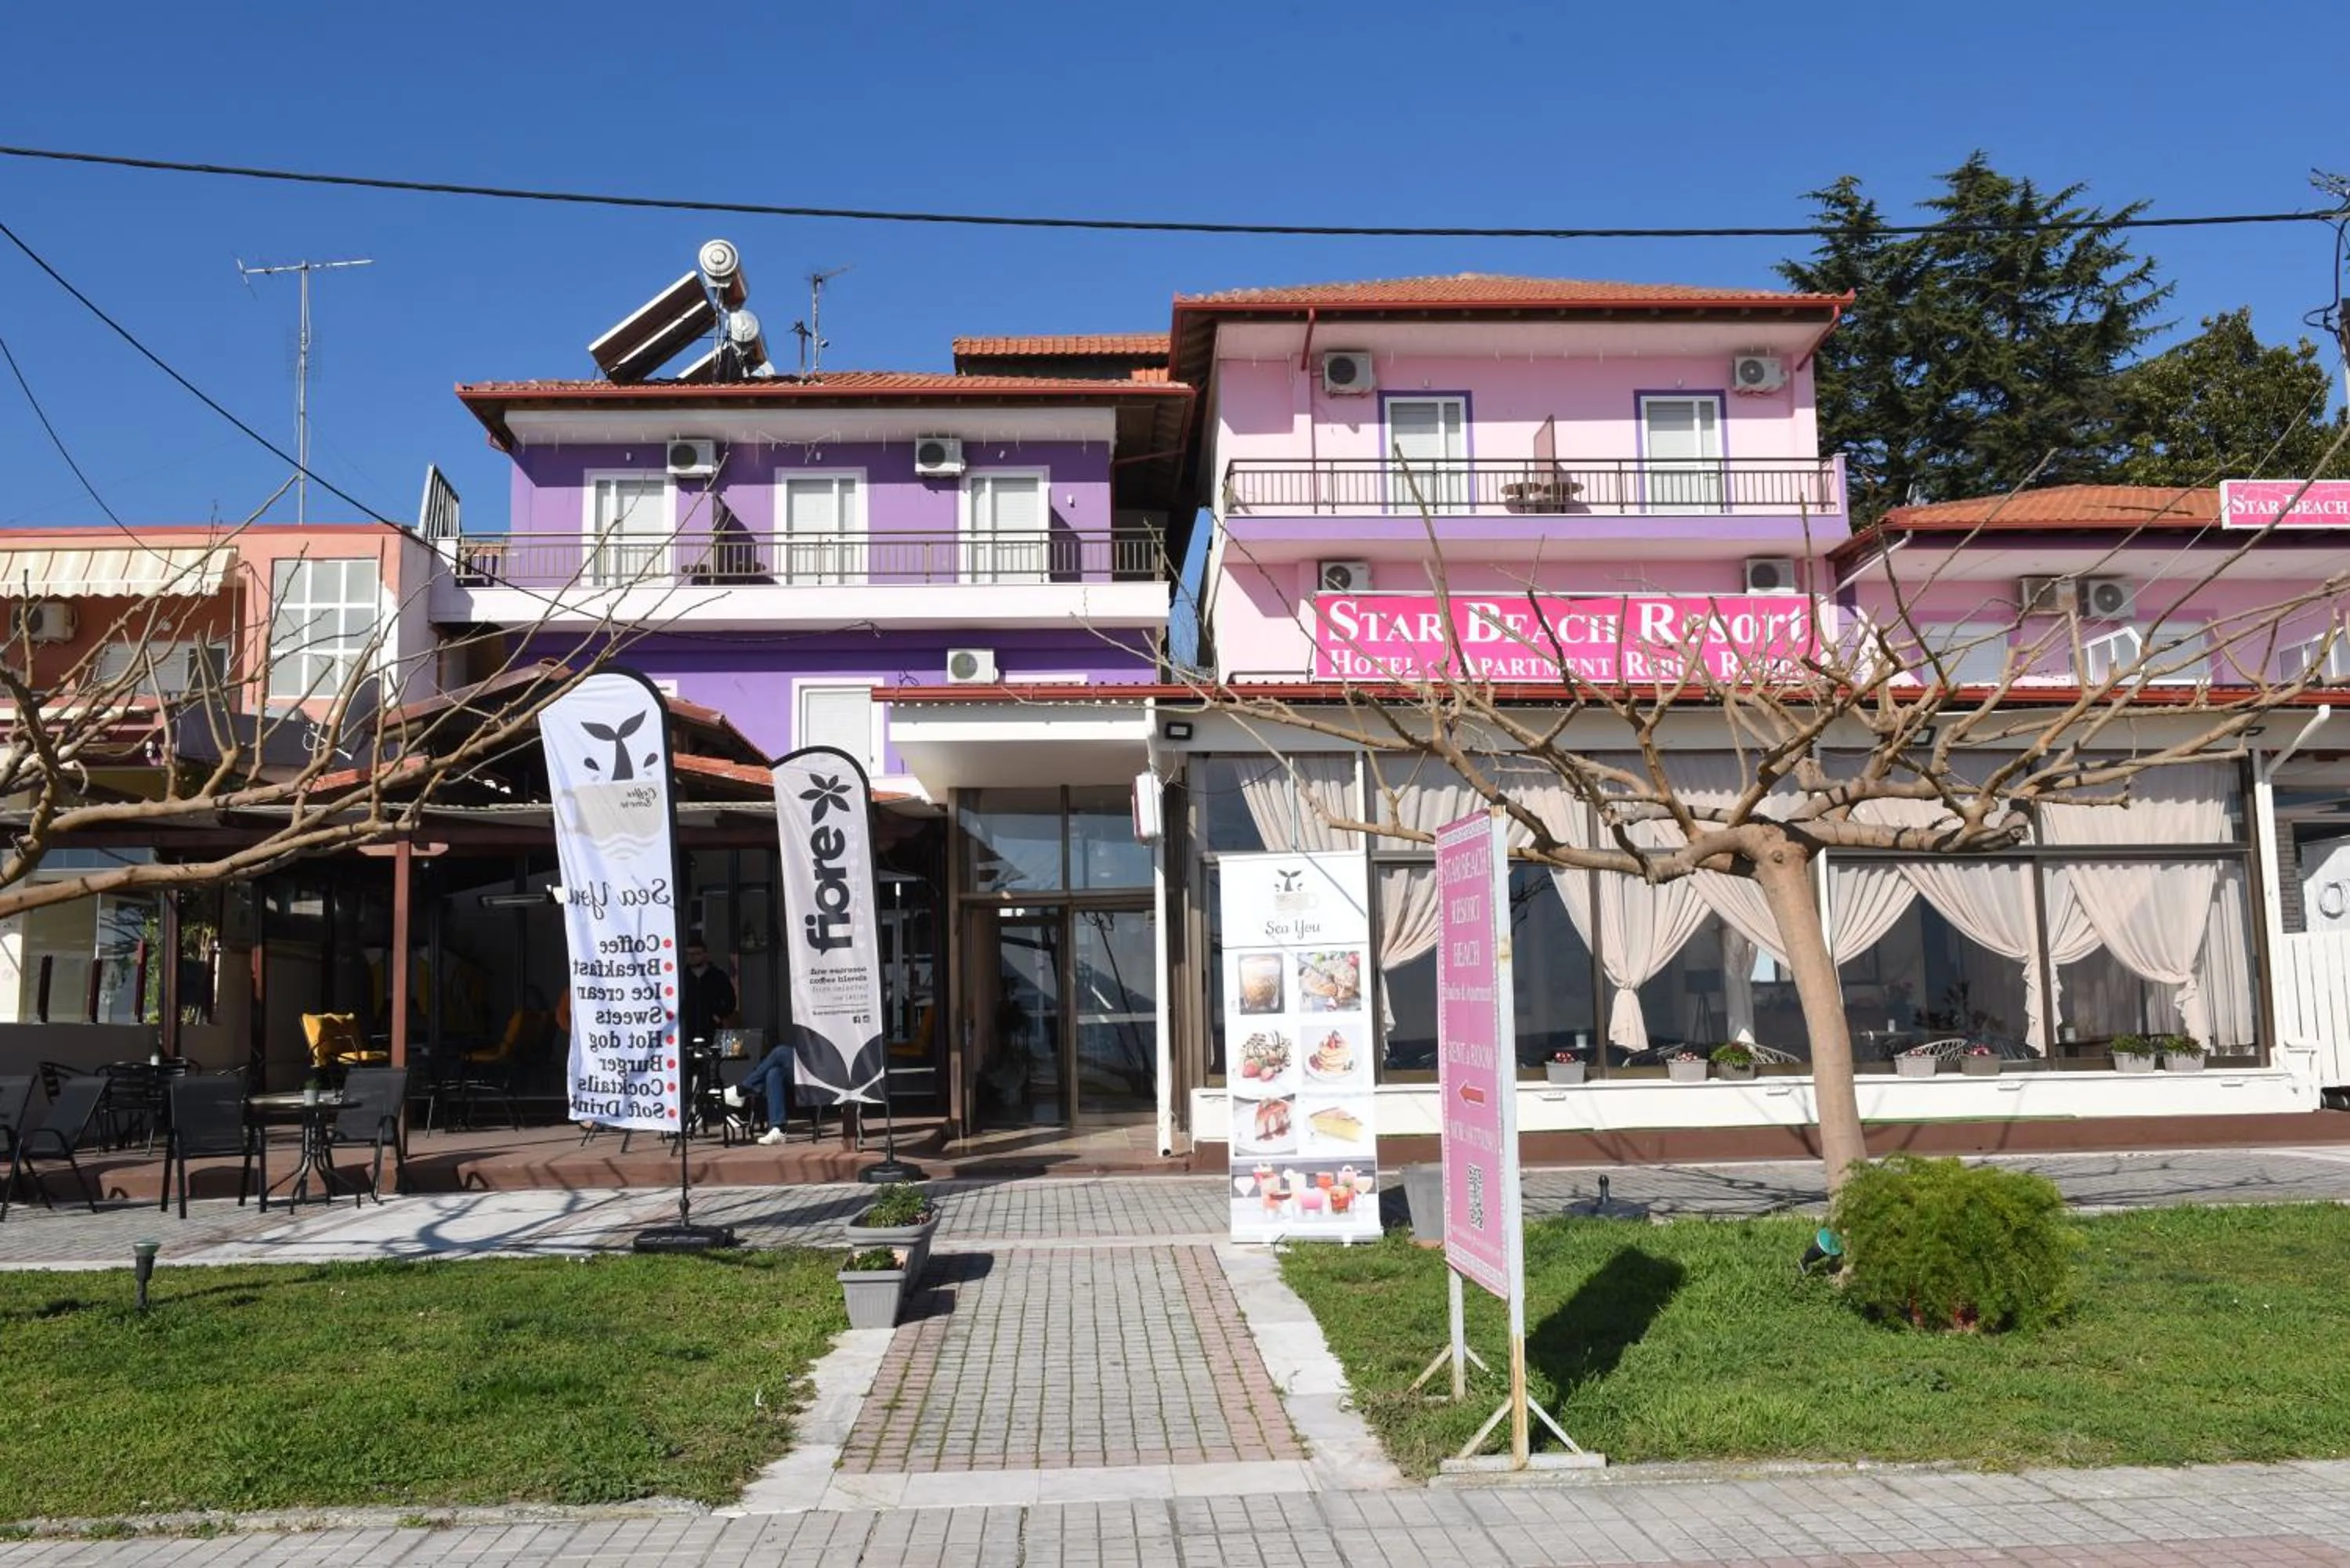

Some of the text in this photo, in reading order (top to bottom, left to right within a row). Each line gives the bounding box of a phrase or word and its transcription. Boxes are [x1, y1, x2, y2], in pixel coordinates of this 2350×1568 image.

[2232, 494, 2279, 515] STAR
[1329, 600, 1807, 644] STAR BEACH Resort
[1329, 649, 1420, 675] HOTEL
[1455, 651, 1611, 677] APARTMENT
[804, 825, 853, 956] fiore
